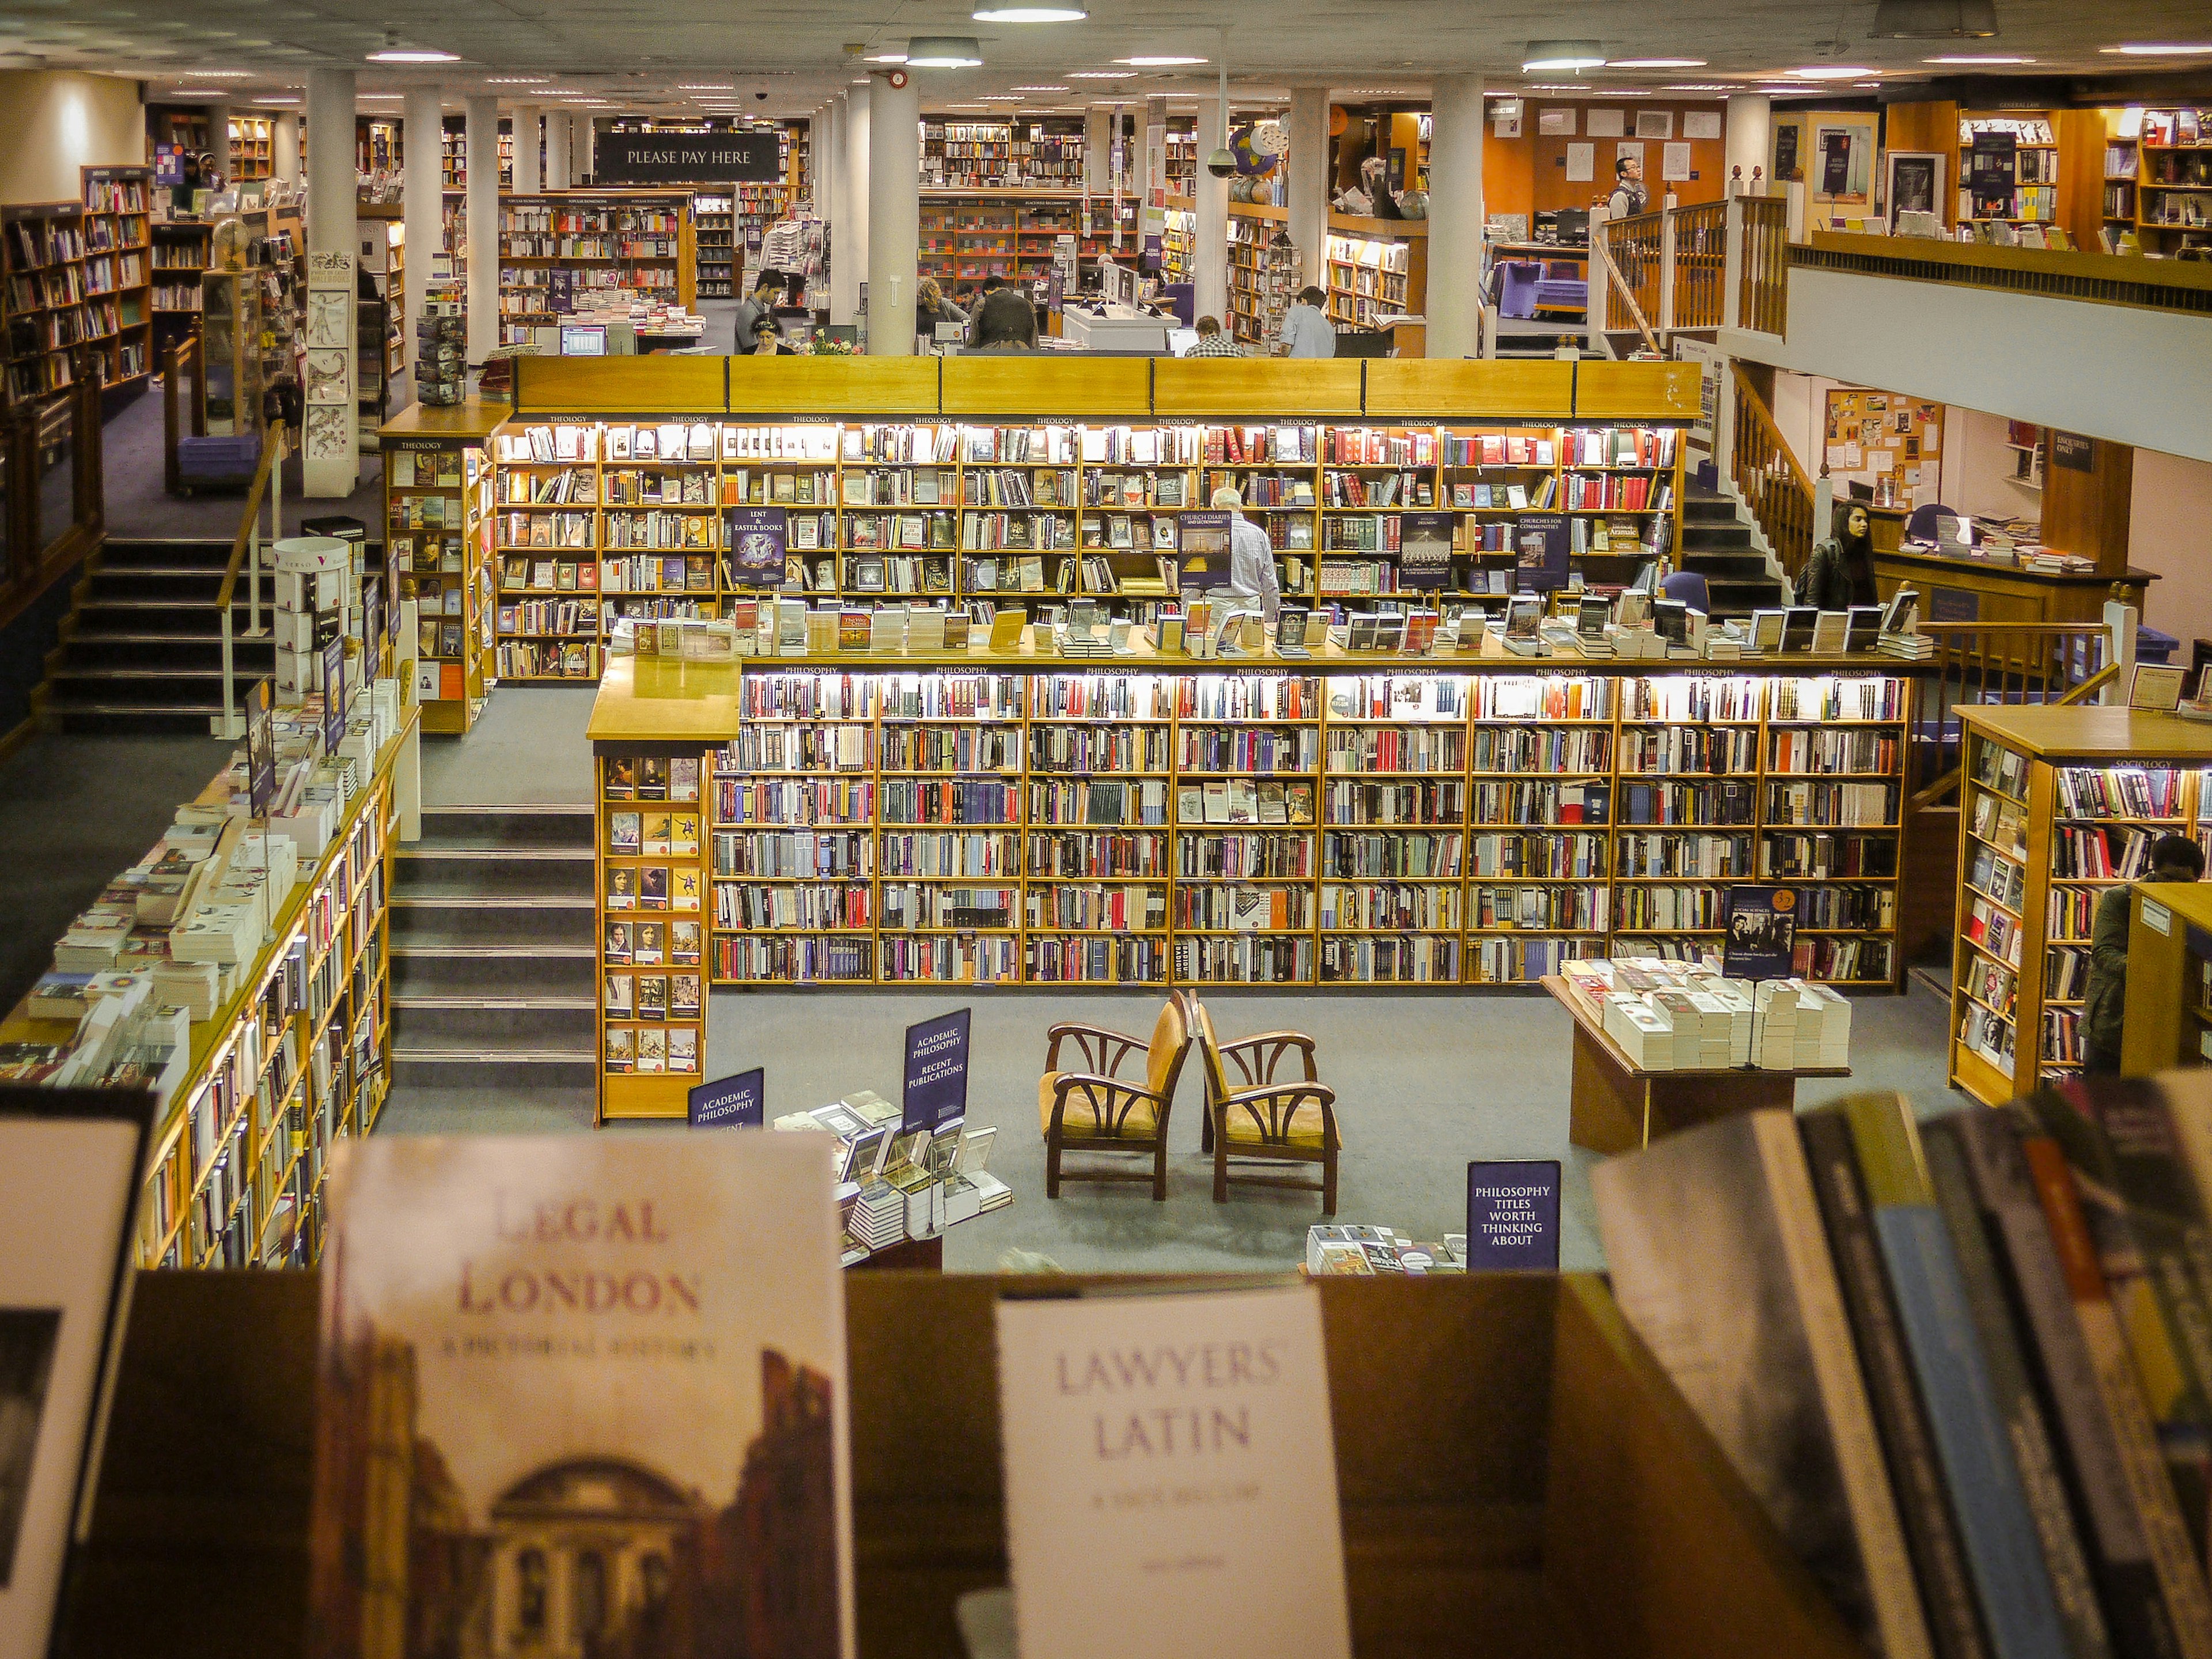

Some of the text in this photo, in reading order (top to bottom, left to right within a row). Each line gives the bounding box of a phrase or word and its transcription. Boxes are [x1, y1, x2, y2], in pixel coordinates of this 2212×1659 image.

[628, 151, 751, 164] PLEASE PAY HERE
[2116, 760, 2172, 769] SOCIOLOGY
[917, 1028, 958, 1048] ACADEMIC
[913, 1037, 961, 1059] PHILOSOPHY
[922, 1058, 952, 1075] RECENT
[908, 1063, 964, 1089] PUBLICATIONS
[702, 1089, 751, 1111] ACADEMIC
[698, 1098, 755, 1123] PHILOSOPHY
[1475, 1187, 1551, 1198] PHILOSOPHY
[1495, 1199, 1531, 1209] TITLES
[494, 1188, 671, 1244] LEGAL
[1489, 1211, 1536, 1221] WORTH
[1482, 1223, 1543, 1233] THINKING
[1491, 1235, 1533, 1245] ABOUT
[459, 1260, 702, 1316] LONDON
[1096, 1404, 1251, 1461] LATIN
